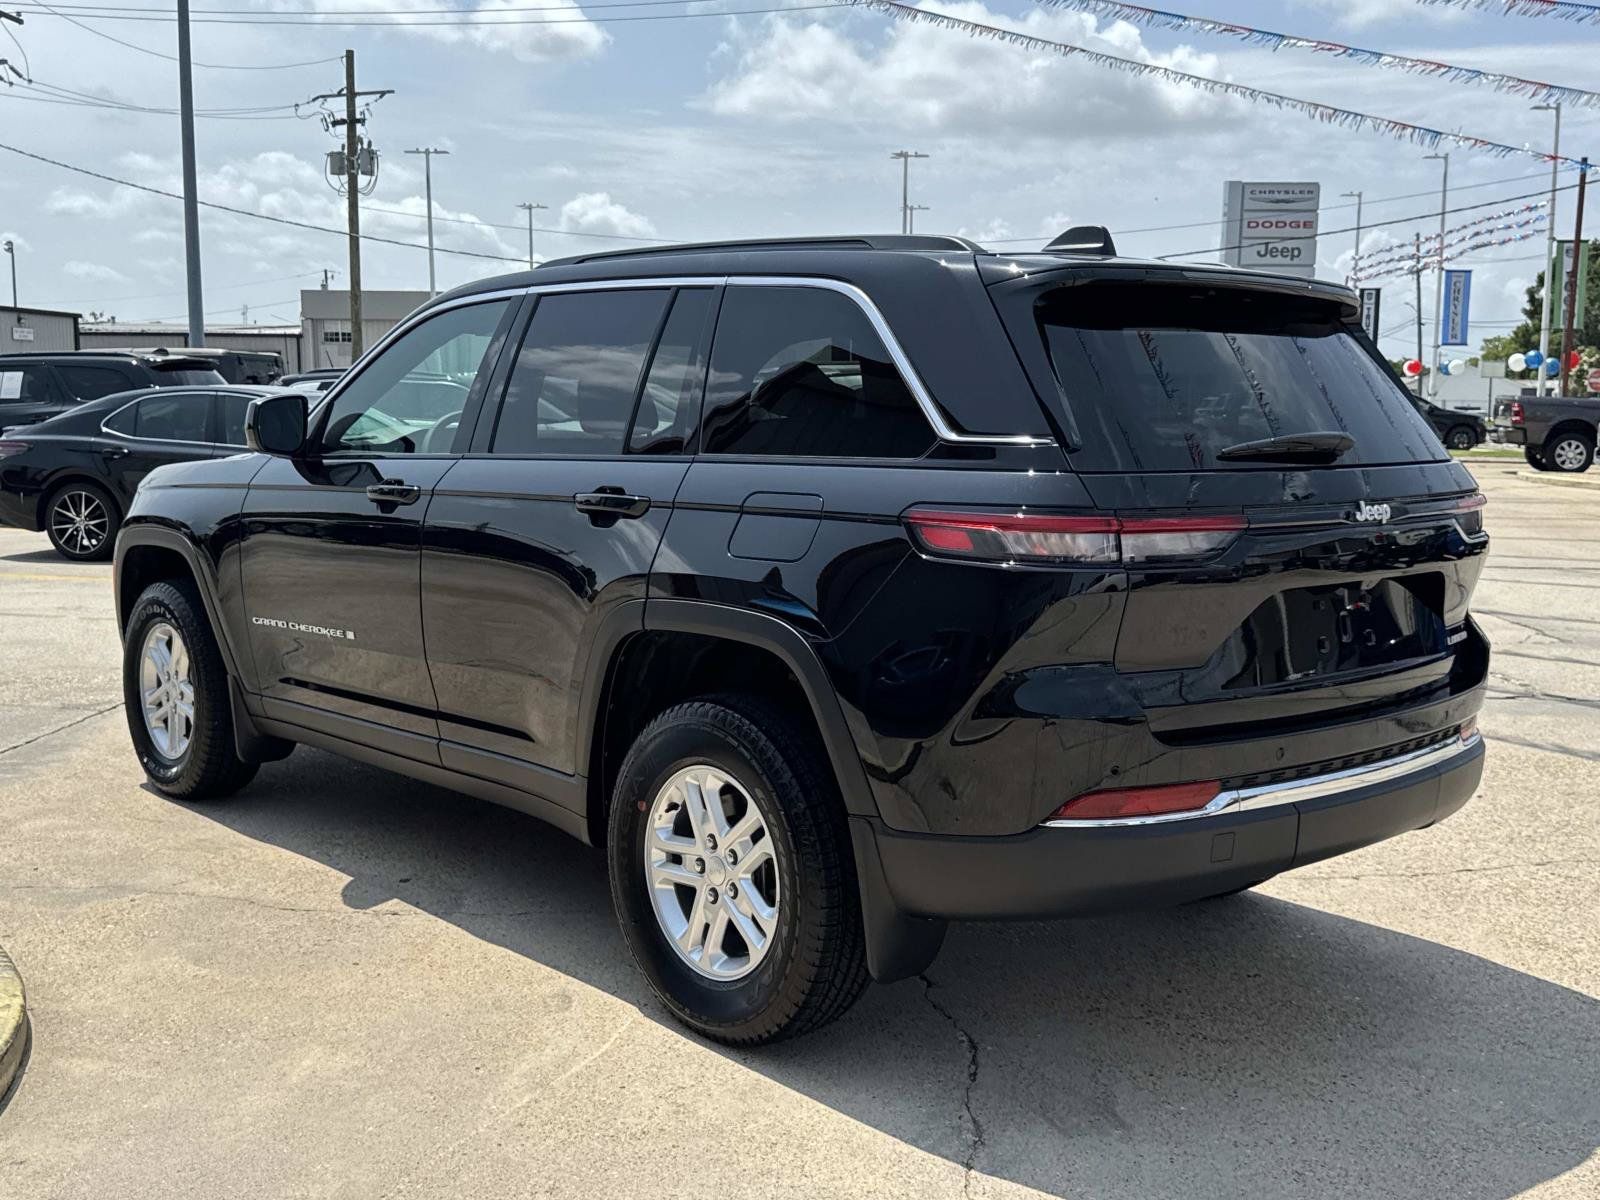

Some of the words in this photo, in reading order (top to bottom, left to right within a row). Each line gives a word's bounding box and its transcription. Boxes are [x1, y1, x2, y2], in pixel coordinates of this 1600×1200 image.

[1249, 188, 1315, 196] CHRYSLER
[1247, 220, 1314, 230] DODGE
[1256, 242, 1302, 261] Jeep
[1355, 500, 1391, 524] Jeep
[252, 617, 287, 629] GRAND
[288, 622, 345, 638] CHEROKEE
